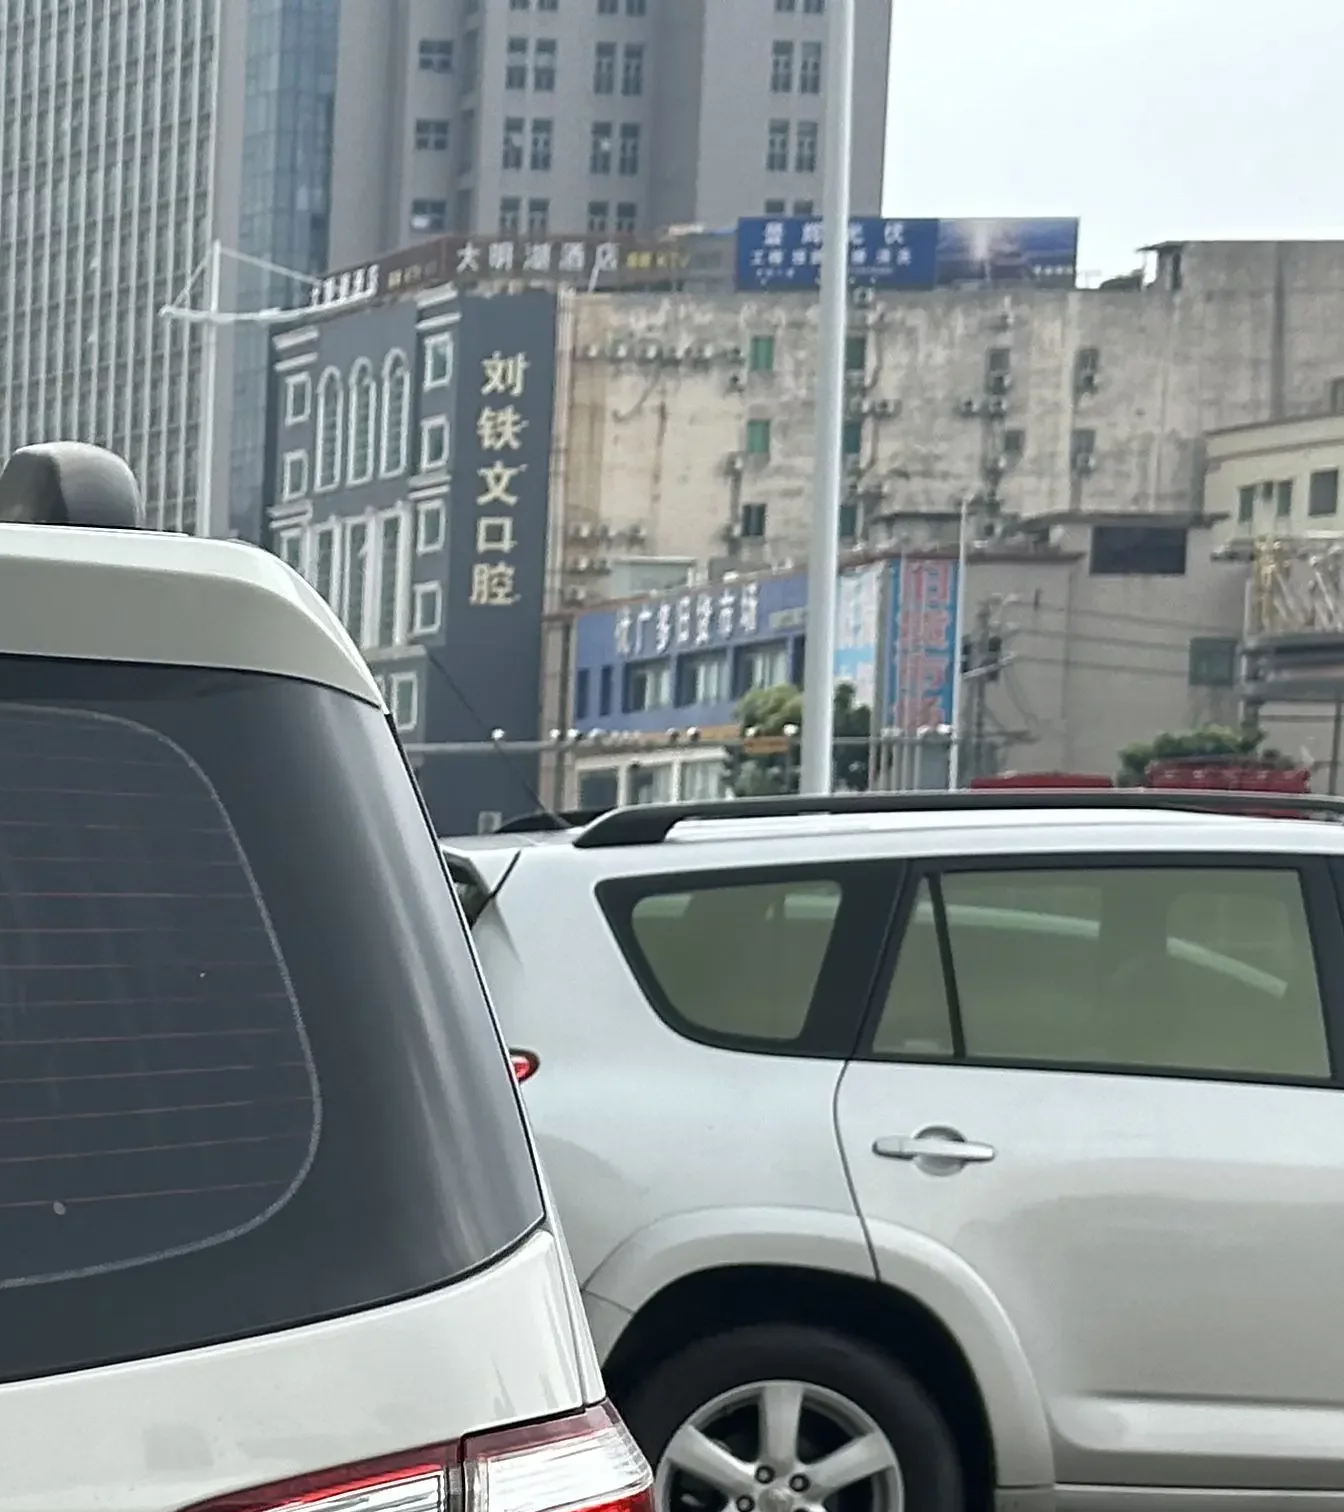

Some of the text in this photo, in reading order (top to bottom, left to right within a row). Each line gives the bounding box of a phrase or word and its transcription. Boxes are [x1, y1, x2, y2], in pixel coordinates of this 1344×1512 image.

[469, 350, 530, 607] 刘铁文口腔
